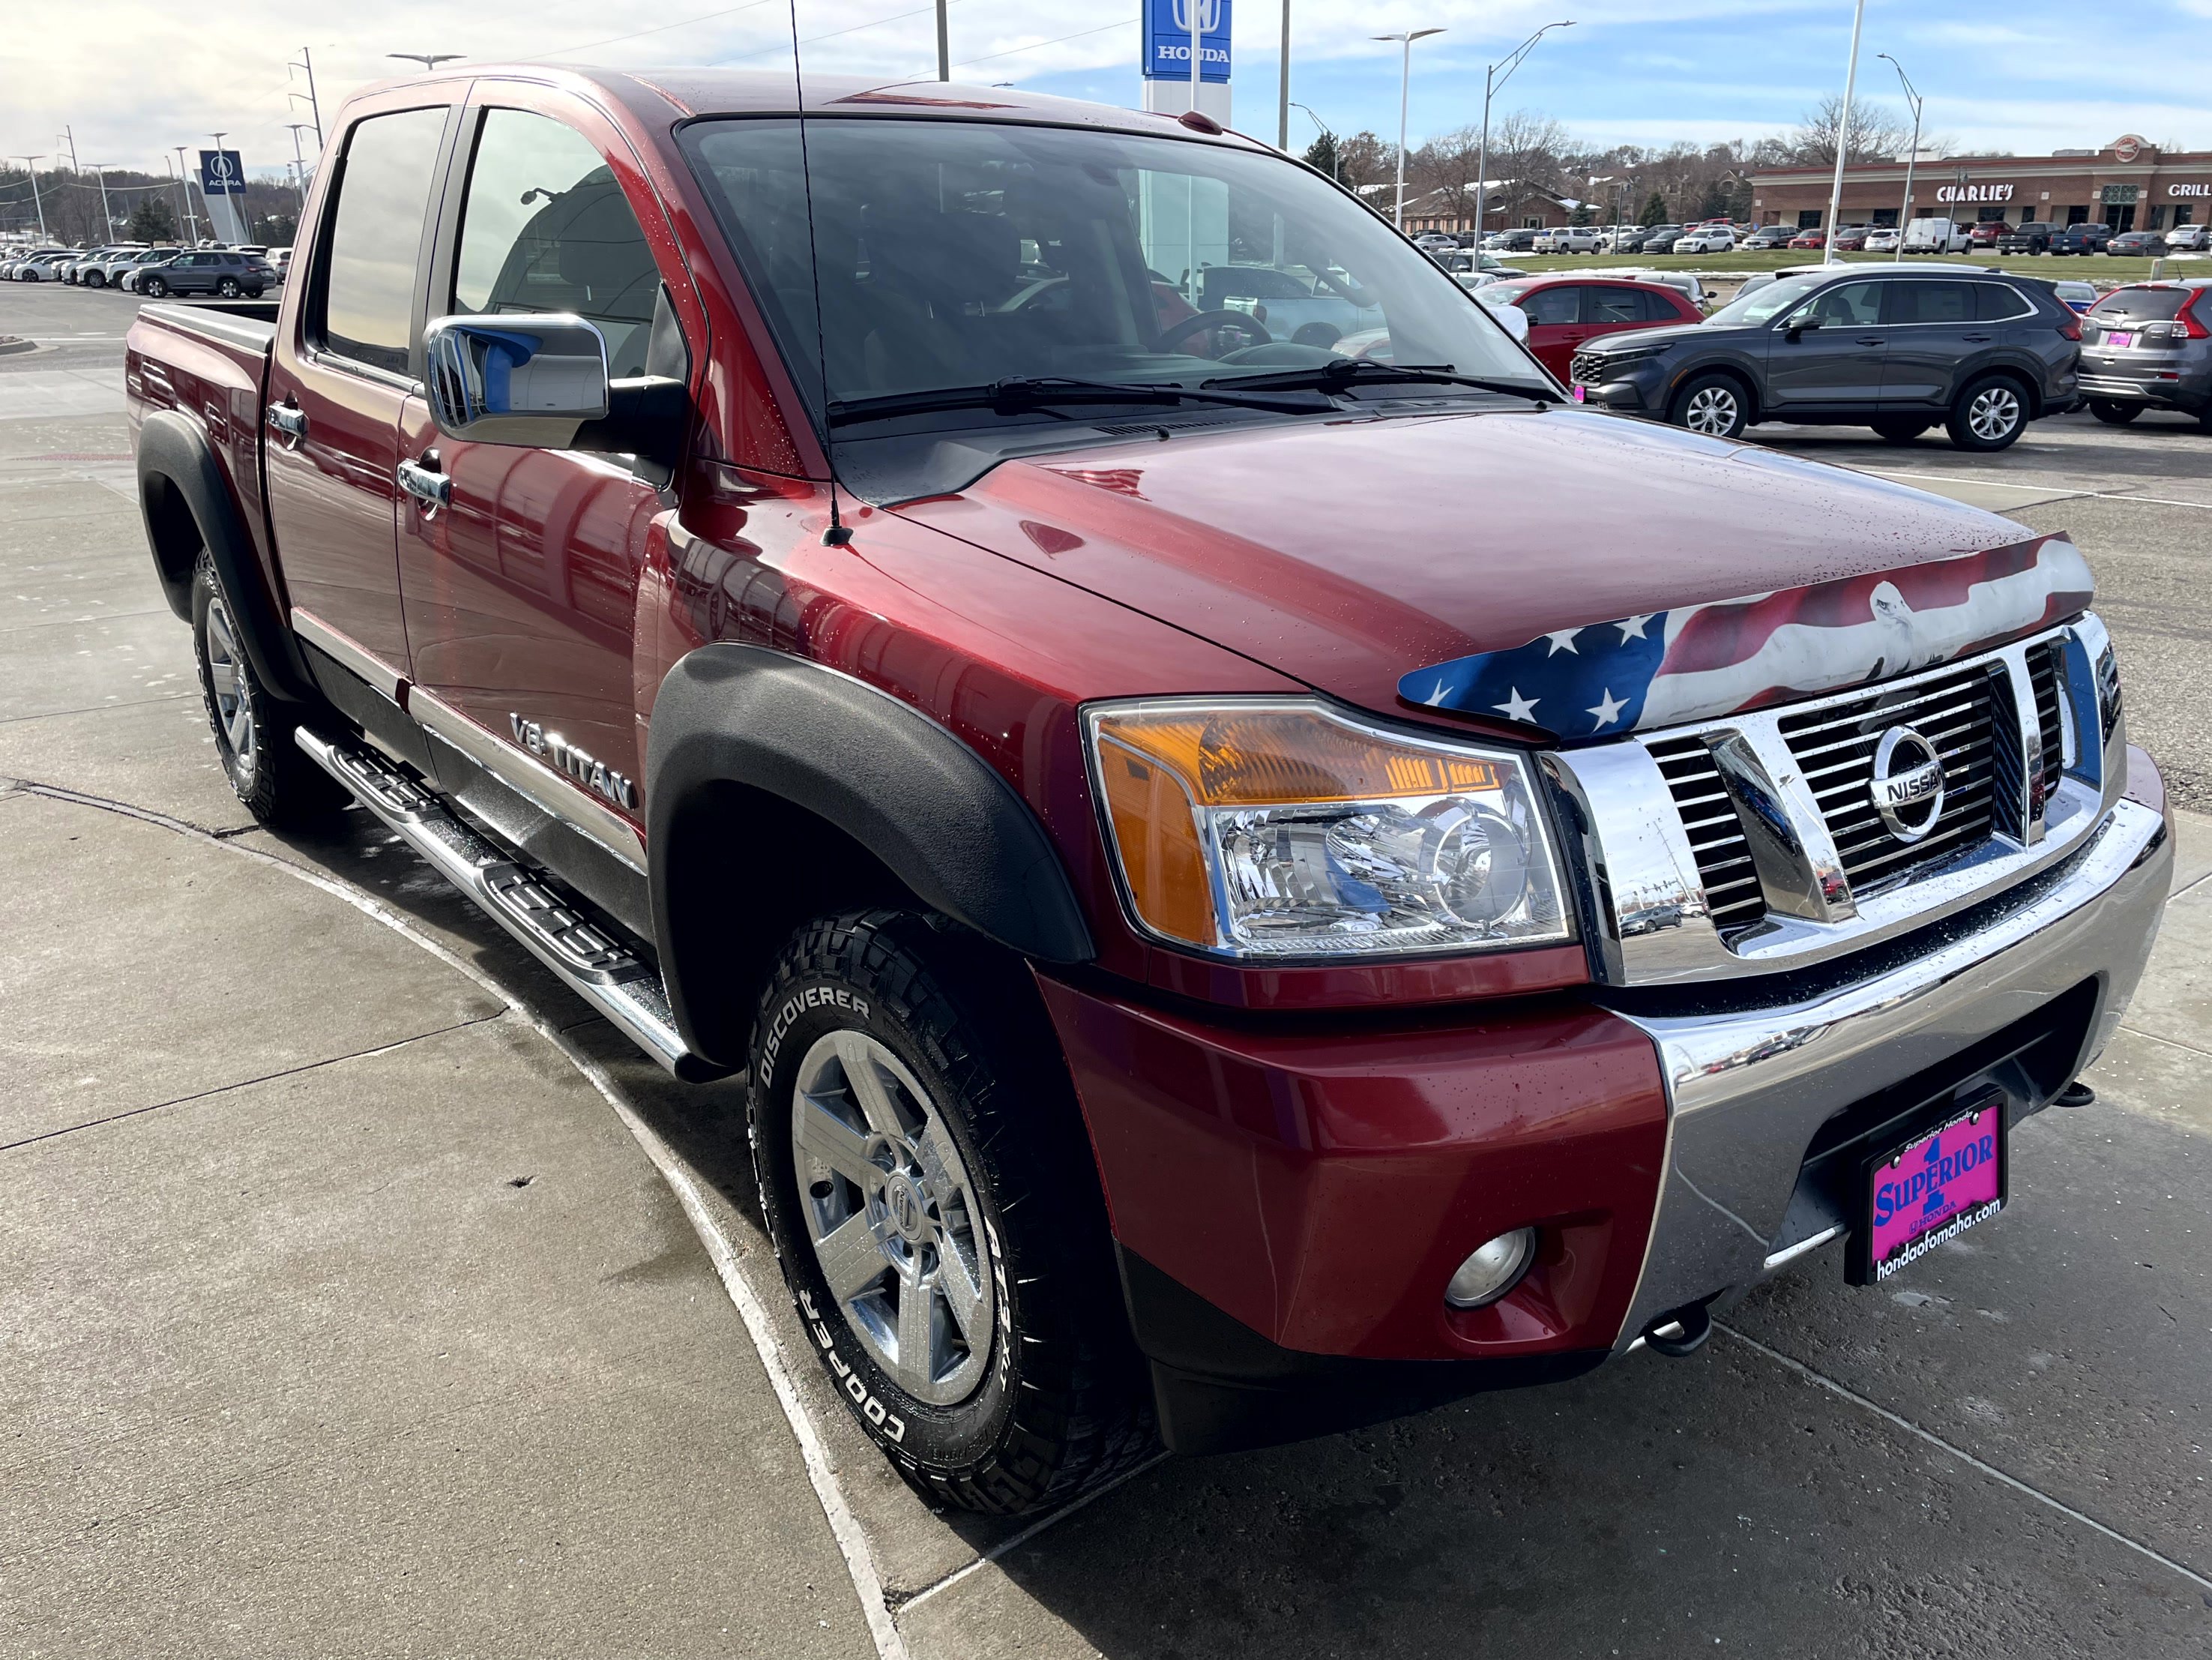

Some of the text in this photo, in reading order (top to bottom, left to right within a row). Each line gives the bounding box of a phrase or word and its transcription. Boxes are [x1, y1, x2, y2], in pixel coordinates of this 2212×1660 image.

[1937, 184, 2013, 202] CHARLIE'S
[2169, 184, 2212, 196] GRILL
[510, 712, 638, 810] V8 TITAN
[760, 987, 870, 1089] DISCOVERER
[1904, 1110, 1973, 1152] Superior Honda
[1876, 1199, 2001, 1281] hondaofomaha.com
[1919, 1200, 1956, 1227] HONDA
[799, 1287, 905, 1443] COOPER
